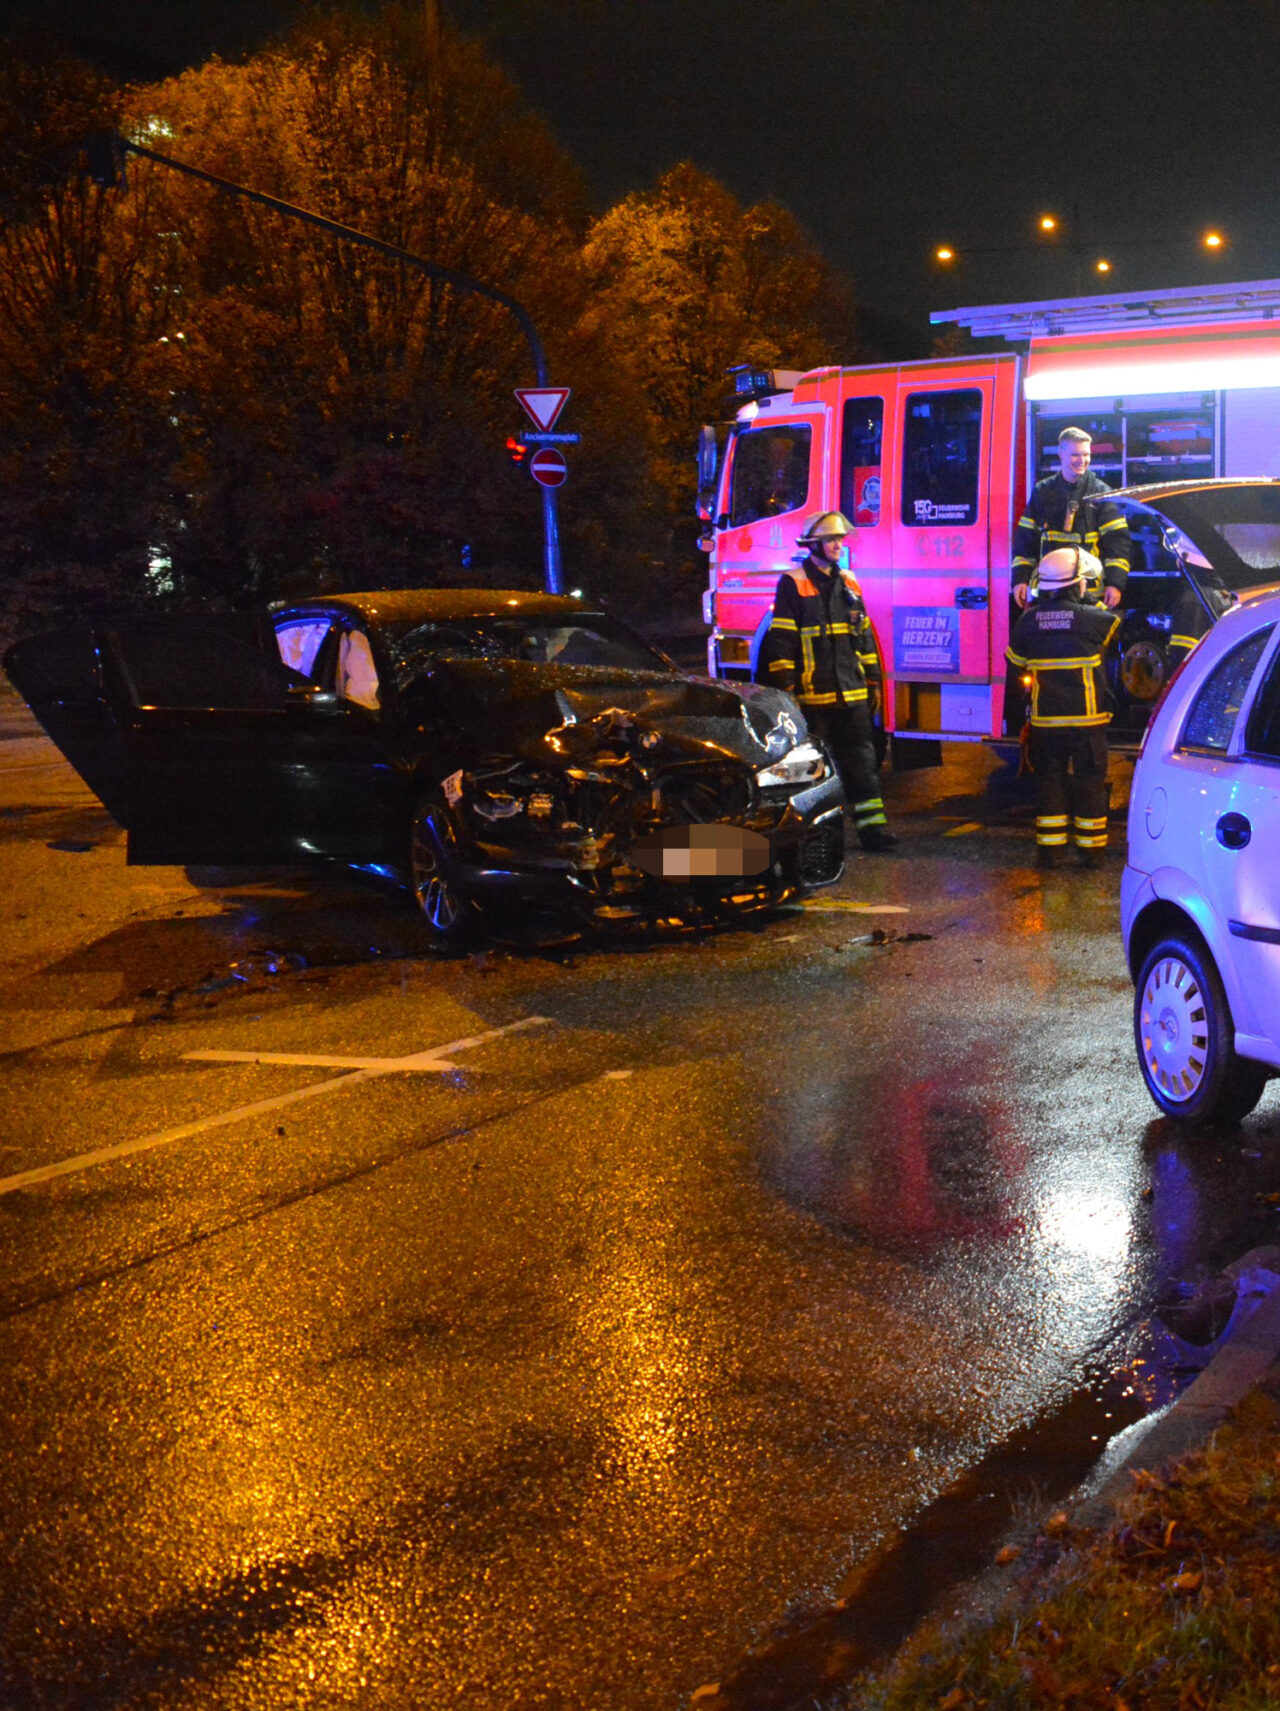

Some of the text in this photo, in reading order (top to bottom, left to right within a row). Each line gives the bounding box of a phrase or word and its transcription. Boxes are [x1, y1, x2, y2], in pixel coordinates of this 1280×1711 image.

[913, 499, 932, 515] 150
[933, 535, 965, 557] 112
[1035, 610, 1074, 620] FEUERWEHR
[905, 616, 947, 630] FEUER IM
[1039, 620, 1071, 630] HAMBURG
[902, 631, 951, 646] HERZEN?
